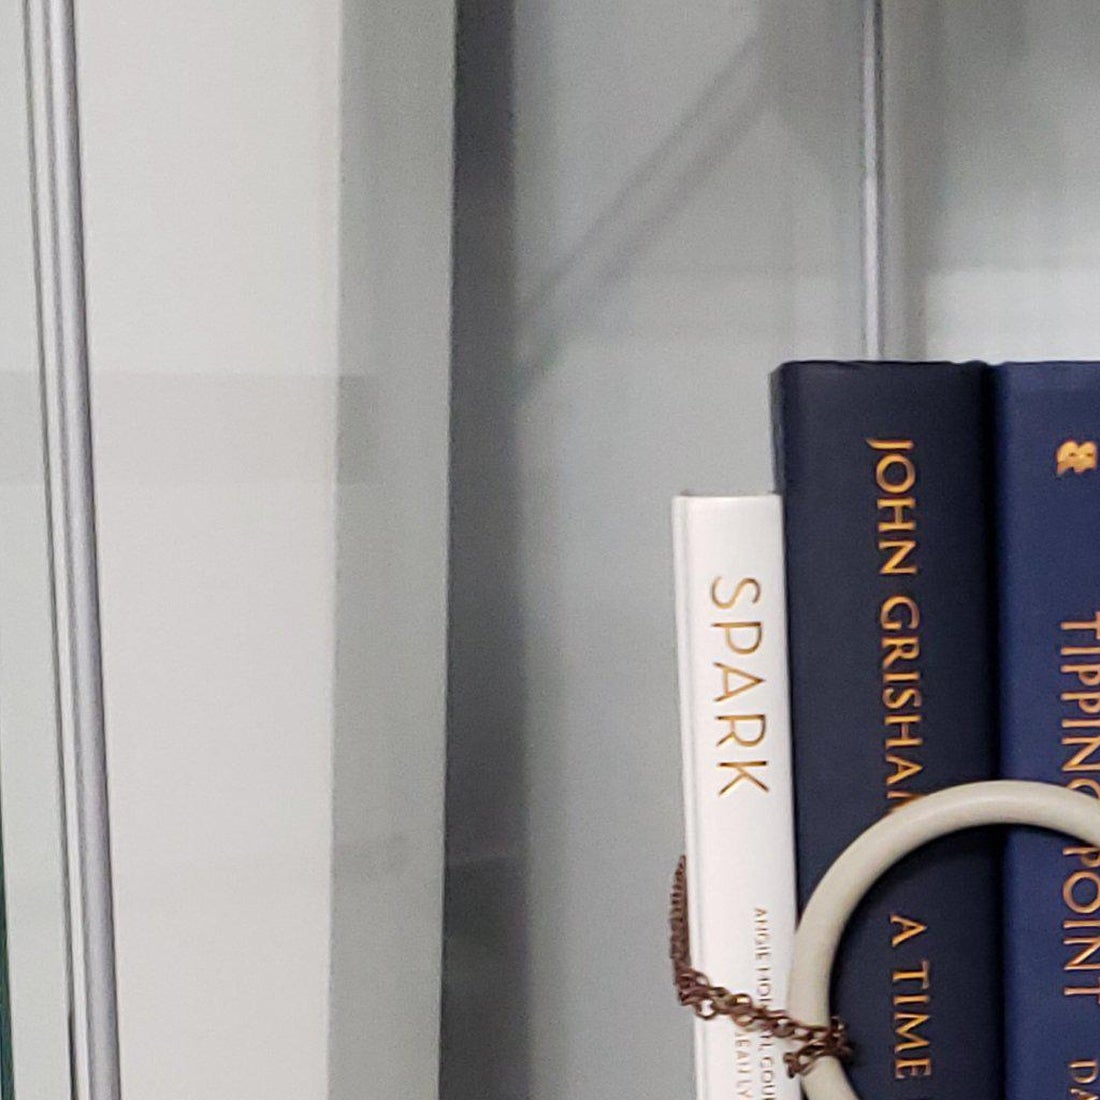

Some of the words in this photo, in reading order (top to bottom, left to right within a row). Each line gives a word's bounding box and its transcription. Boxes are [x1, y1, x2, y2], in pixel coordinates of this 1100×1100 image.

[865, 438, 917, 576] JOHN
[710, 576, 770, 796] SPARK
[889, 913, 927, 948] A
[892, 959, 932, 1079] TIME
